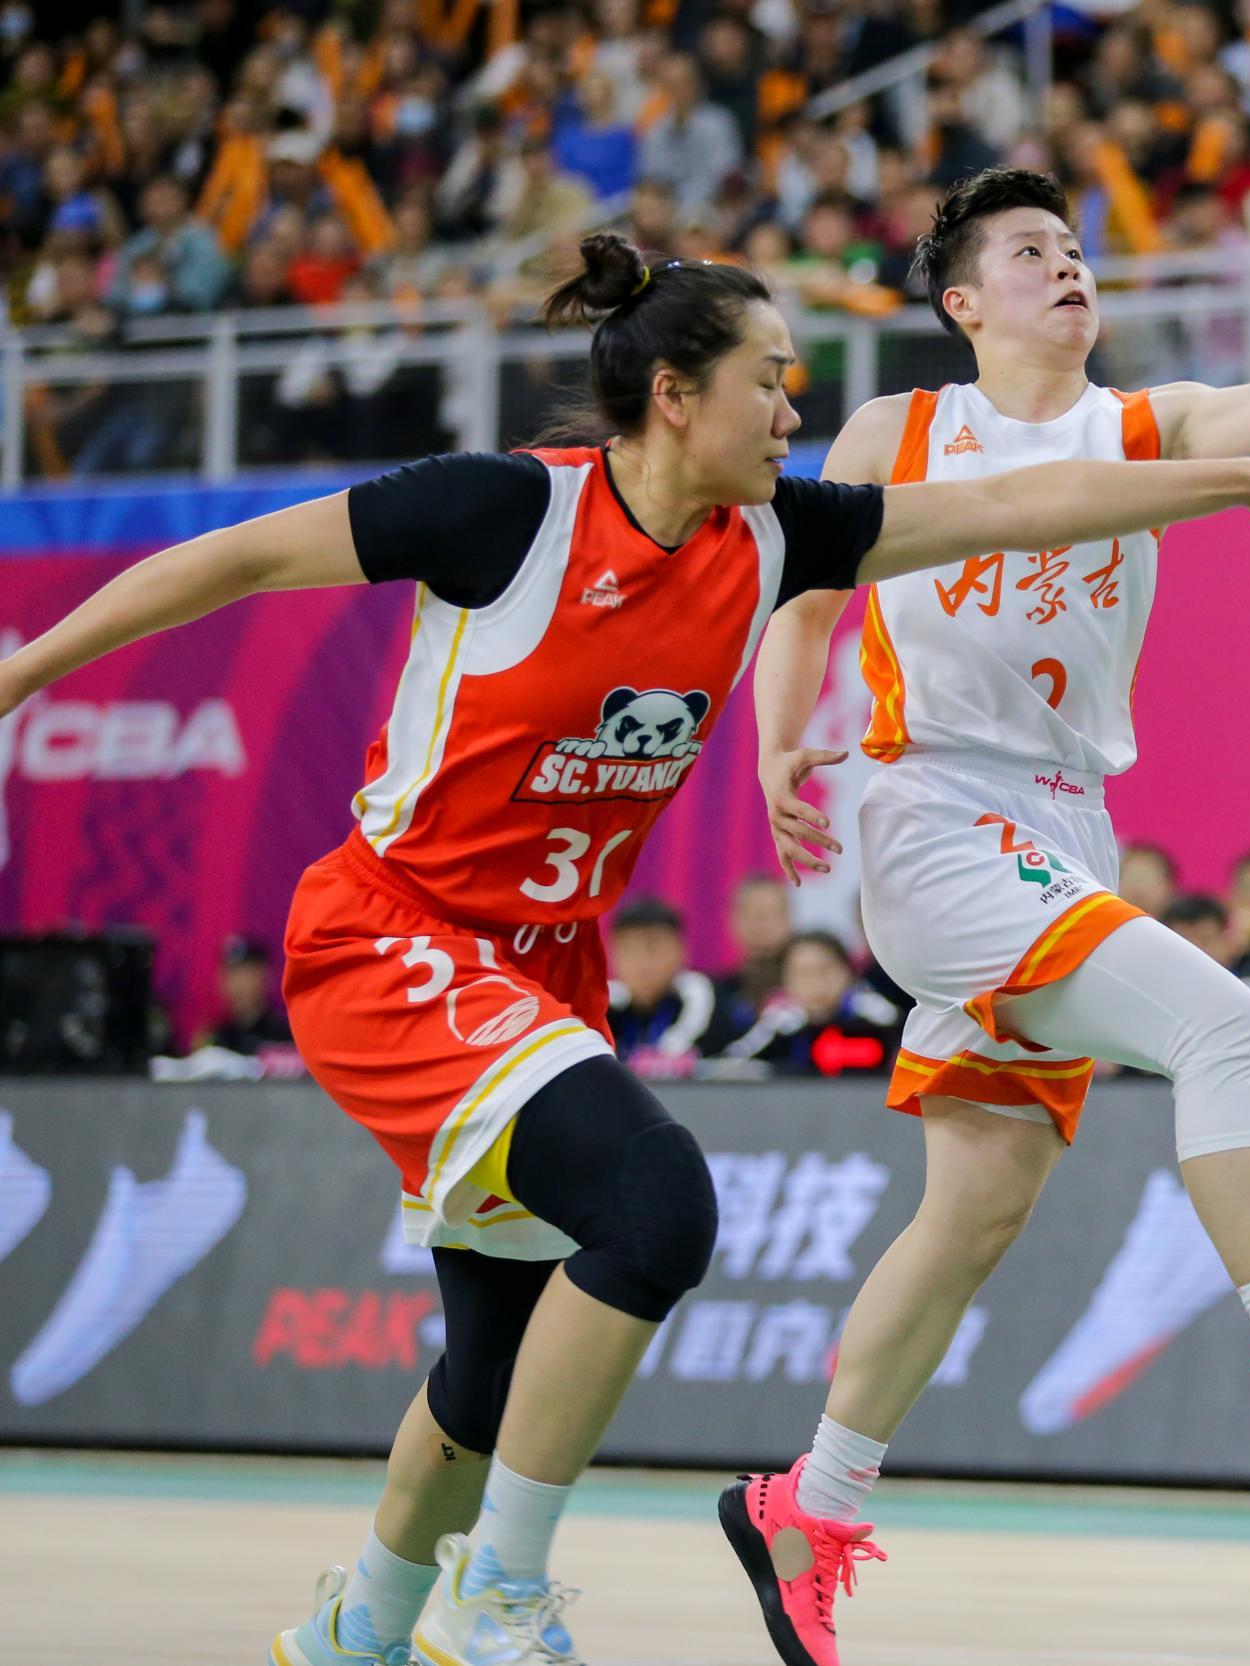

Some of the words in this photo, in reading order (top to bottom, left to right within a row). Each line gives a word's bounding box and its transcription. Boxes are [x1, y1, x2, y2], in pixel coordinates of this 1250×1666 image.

[944, 443, 985, 456] PEAK
[581, 587, 628, 609] PEAK
[934, 537, 1124, 625] 内蒙古
[519, 827, 633, 903] 31
